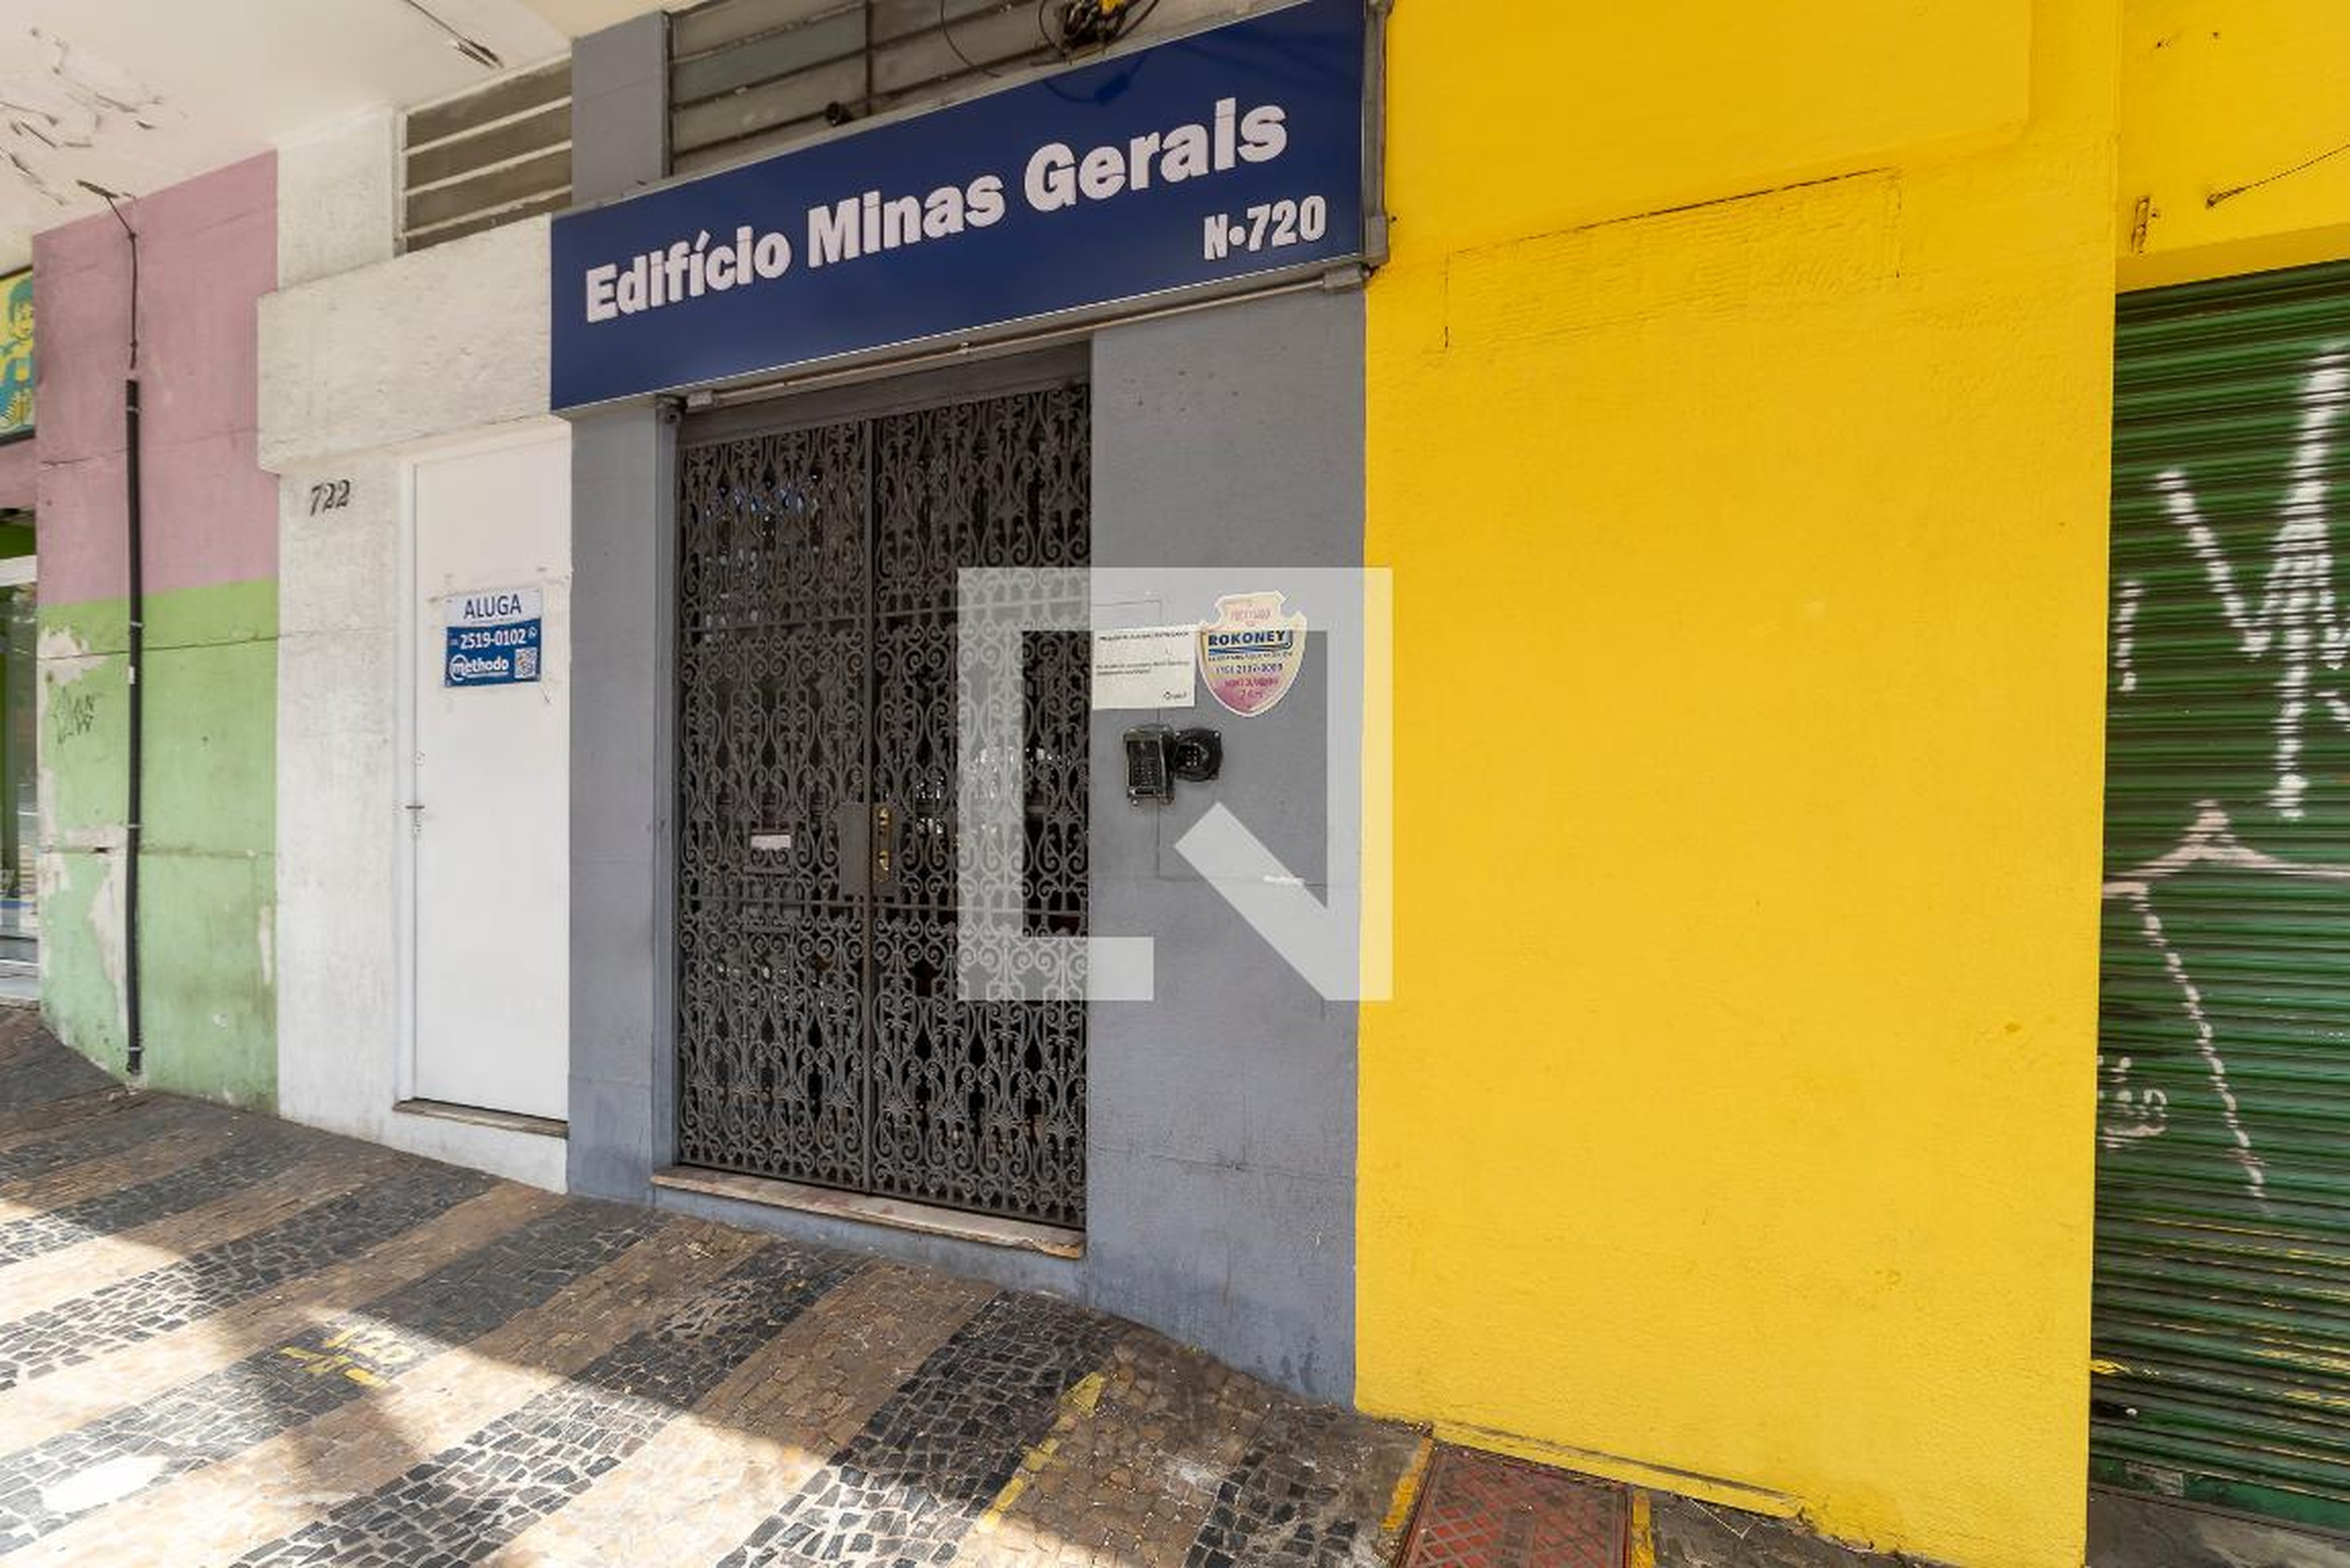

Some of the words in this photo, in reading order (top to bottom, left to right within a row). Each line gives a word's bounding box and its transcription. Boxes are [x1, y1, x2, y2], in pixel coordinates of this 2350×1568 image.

[586, 230, 793, 323] Edifício
[807, 174, 1006, 268] Minas
[1024, 97, 1288, 212] Gerais
[310, 479, 349, 517] 722
[463, 594, 521, 619] ALUGA
[460, 629, 527, 649] 2519-0102
[1208, 630, 1286, 646] ROKONEY
